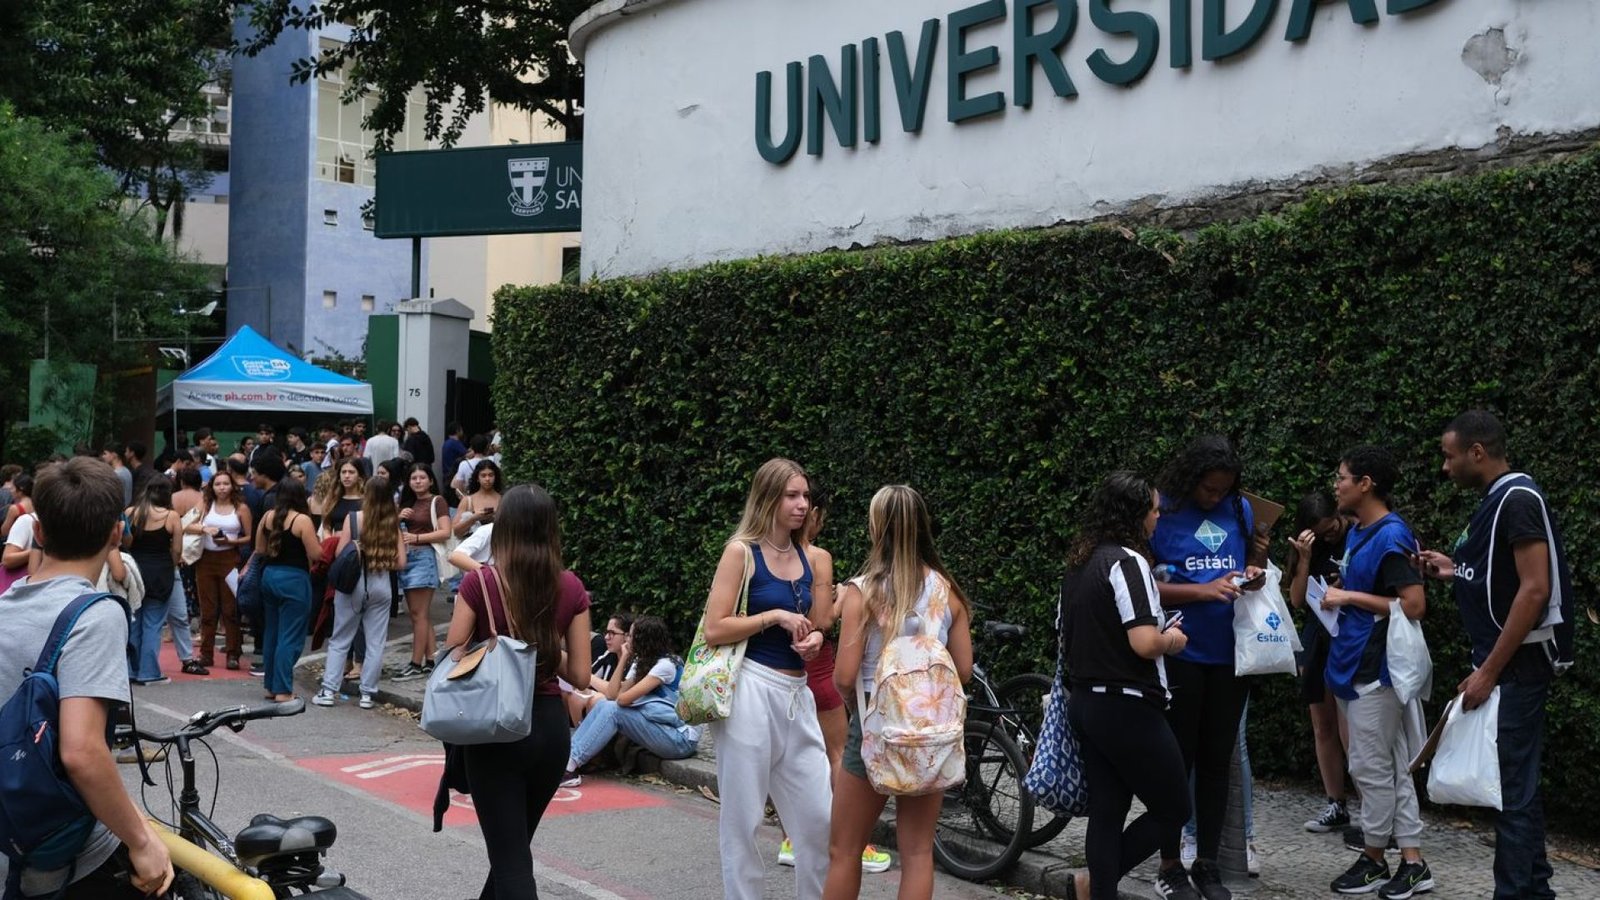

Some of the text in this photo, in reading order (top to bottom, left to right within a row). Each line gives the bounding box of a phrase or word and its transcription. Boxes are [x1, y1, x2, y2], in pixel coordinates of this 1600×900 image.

[755, 0, 1452, 165] UNIVERSID
[555, 189, 580, 210] SA
[188, 391, 222, 401] Acesse
[224, 391, 277, 402] ph.com.br
[287, 391, 330, 403] descubra
[409, 388, 421, 397] 75
